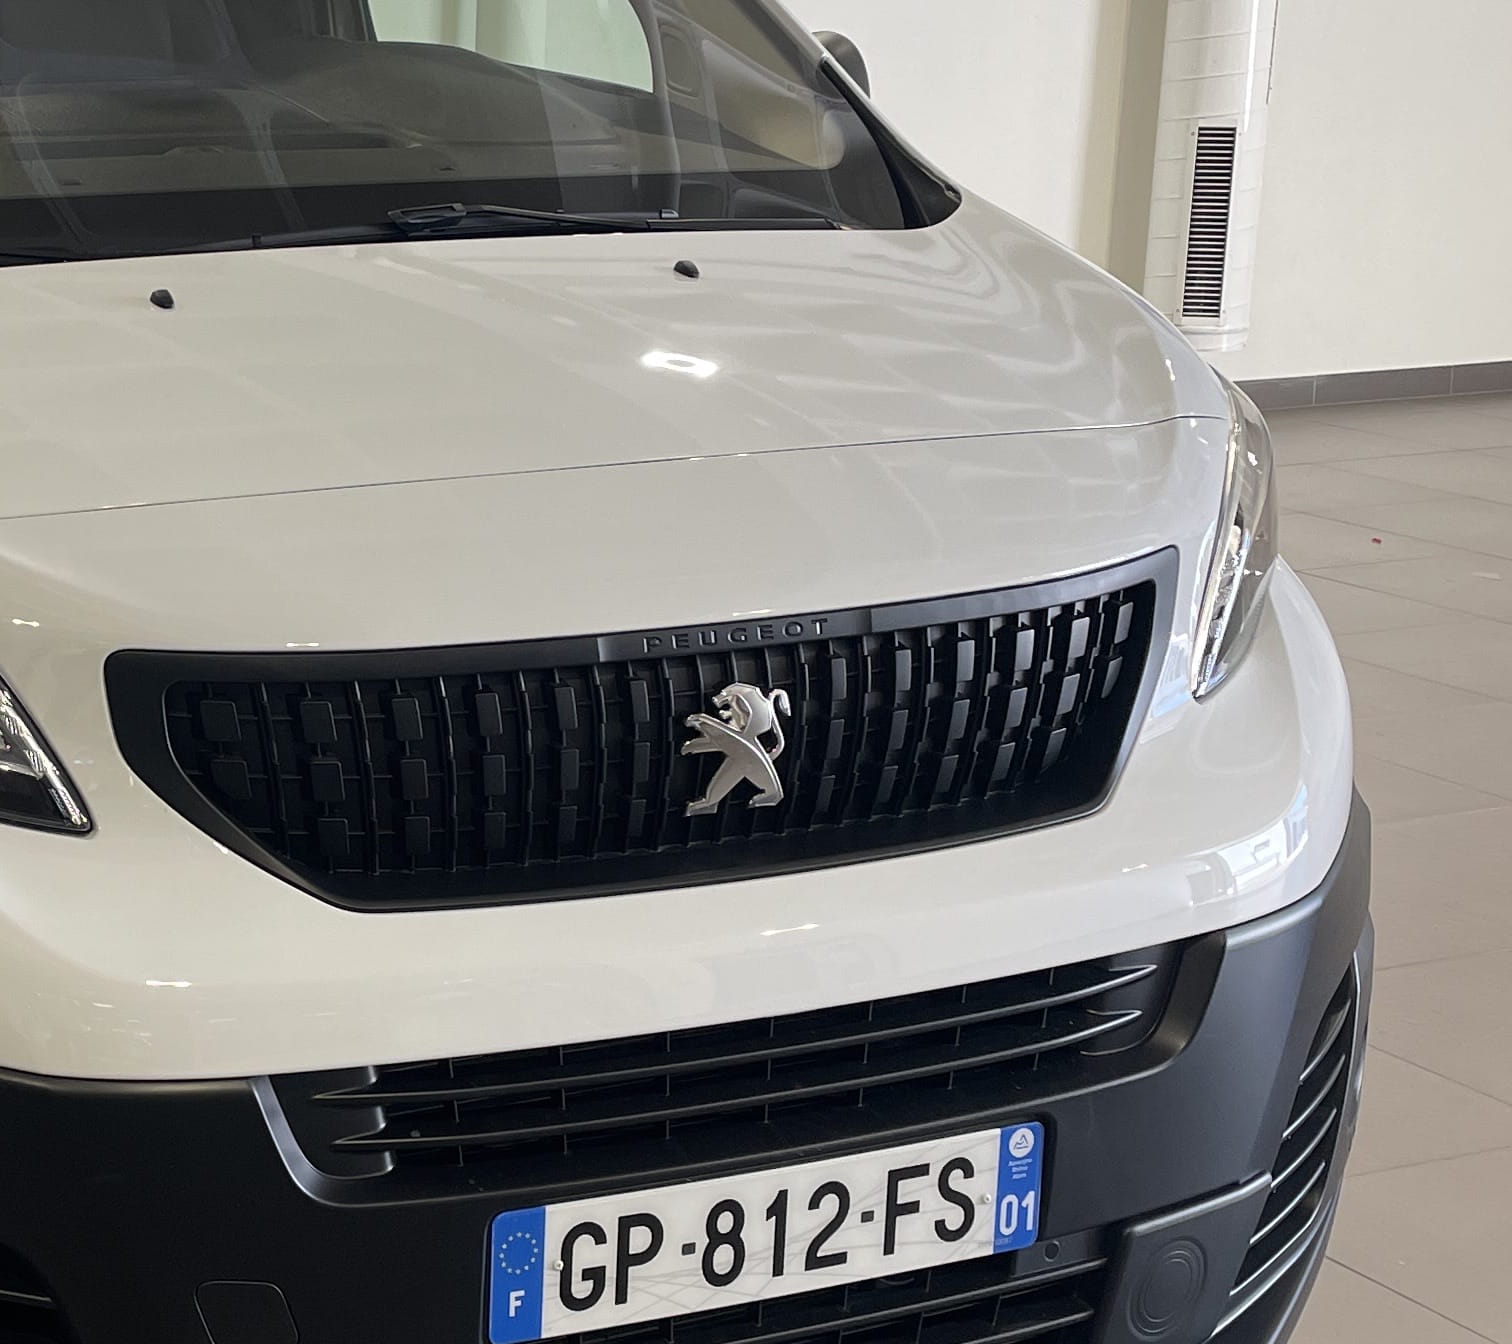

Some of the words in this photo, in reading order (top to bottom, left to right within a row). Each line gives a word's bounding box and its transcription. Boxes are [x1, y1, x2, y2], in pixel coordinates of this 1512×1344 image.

[642, 618, 828, 654] PEUGEOT
[999, 1190, 1035, 1236] 01
[559, 1157, 976, 1312] GP-812-FS
[508, 1289, 525, 1318] F
